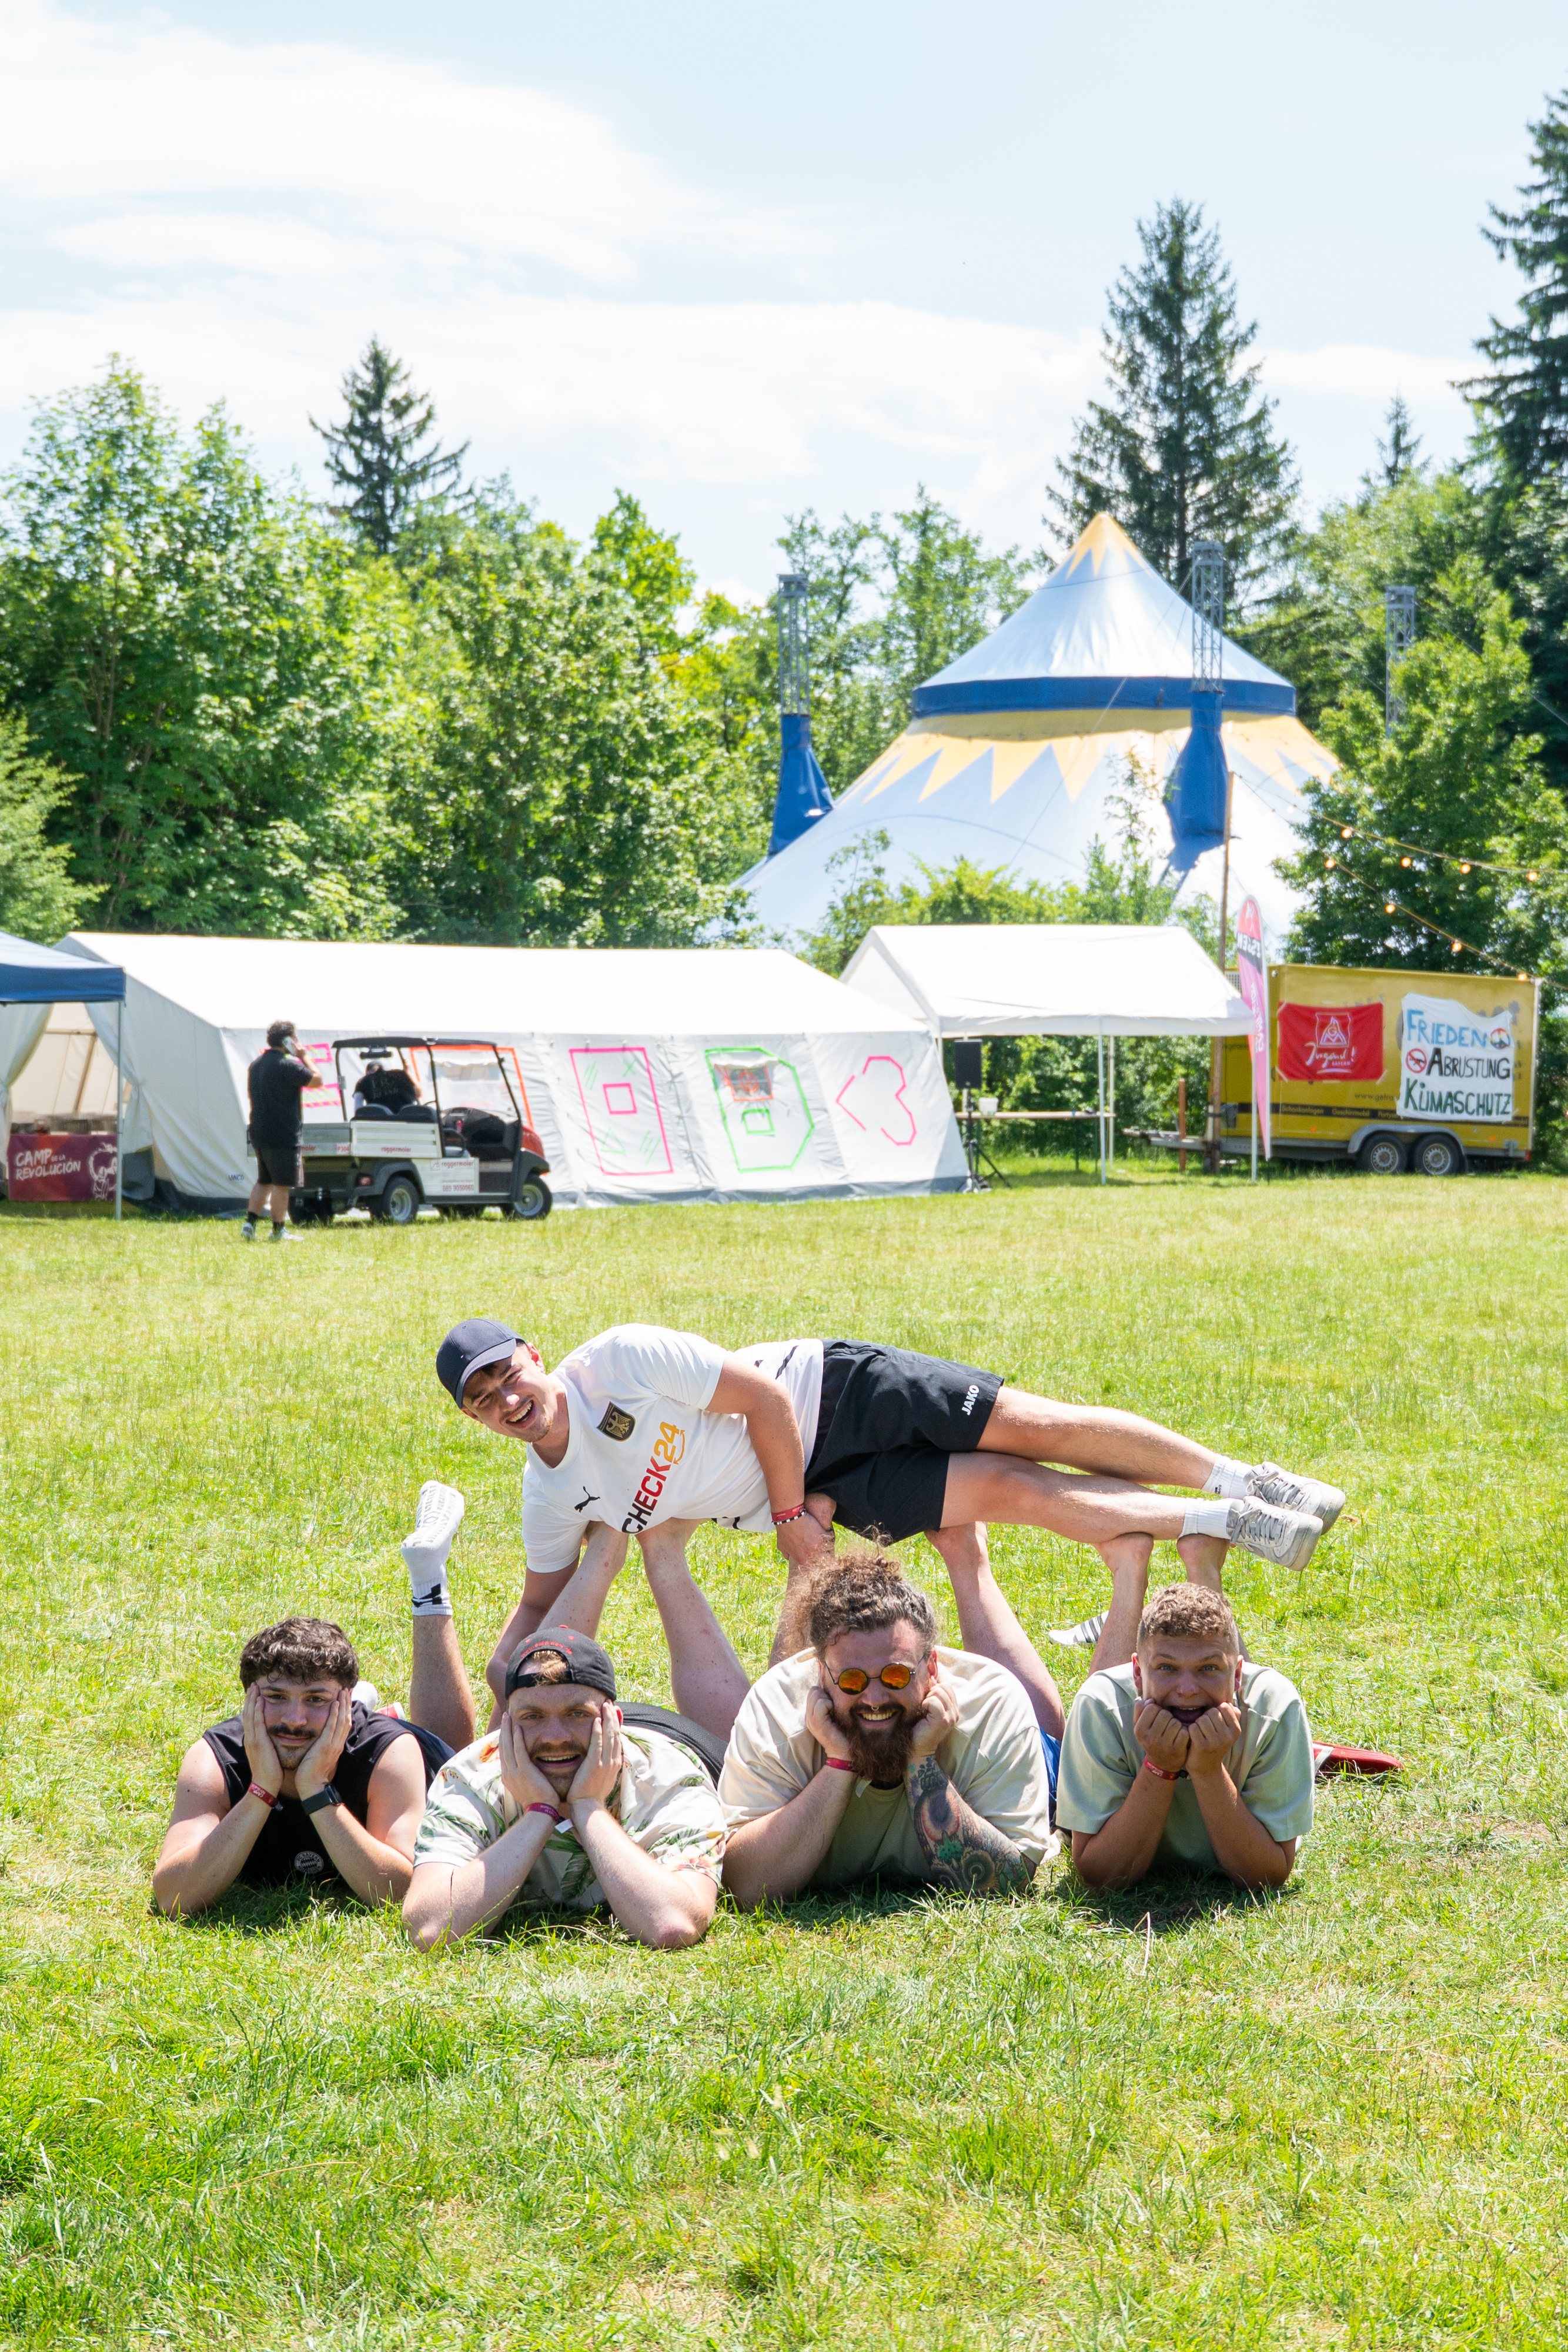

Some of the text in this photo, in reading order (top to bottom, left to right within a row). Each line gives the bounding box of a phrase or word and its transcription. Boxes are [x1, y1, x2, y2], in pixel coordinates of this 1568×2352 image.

[1407, 1008, 1488, 1048] FRIEDEN
[1404, 1078, 1512, 1116] KLIMASCHUTZ
[16, 1148, 52, 1167] CAMP
[16, 1157, 82, 1181] REVOLUCIÓN
[961, 1385, 979, 1416] JAKO
[621, 1421, 680, 1534] CHECK24
[302, 1852, 321, 1862] BAYERN
